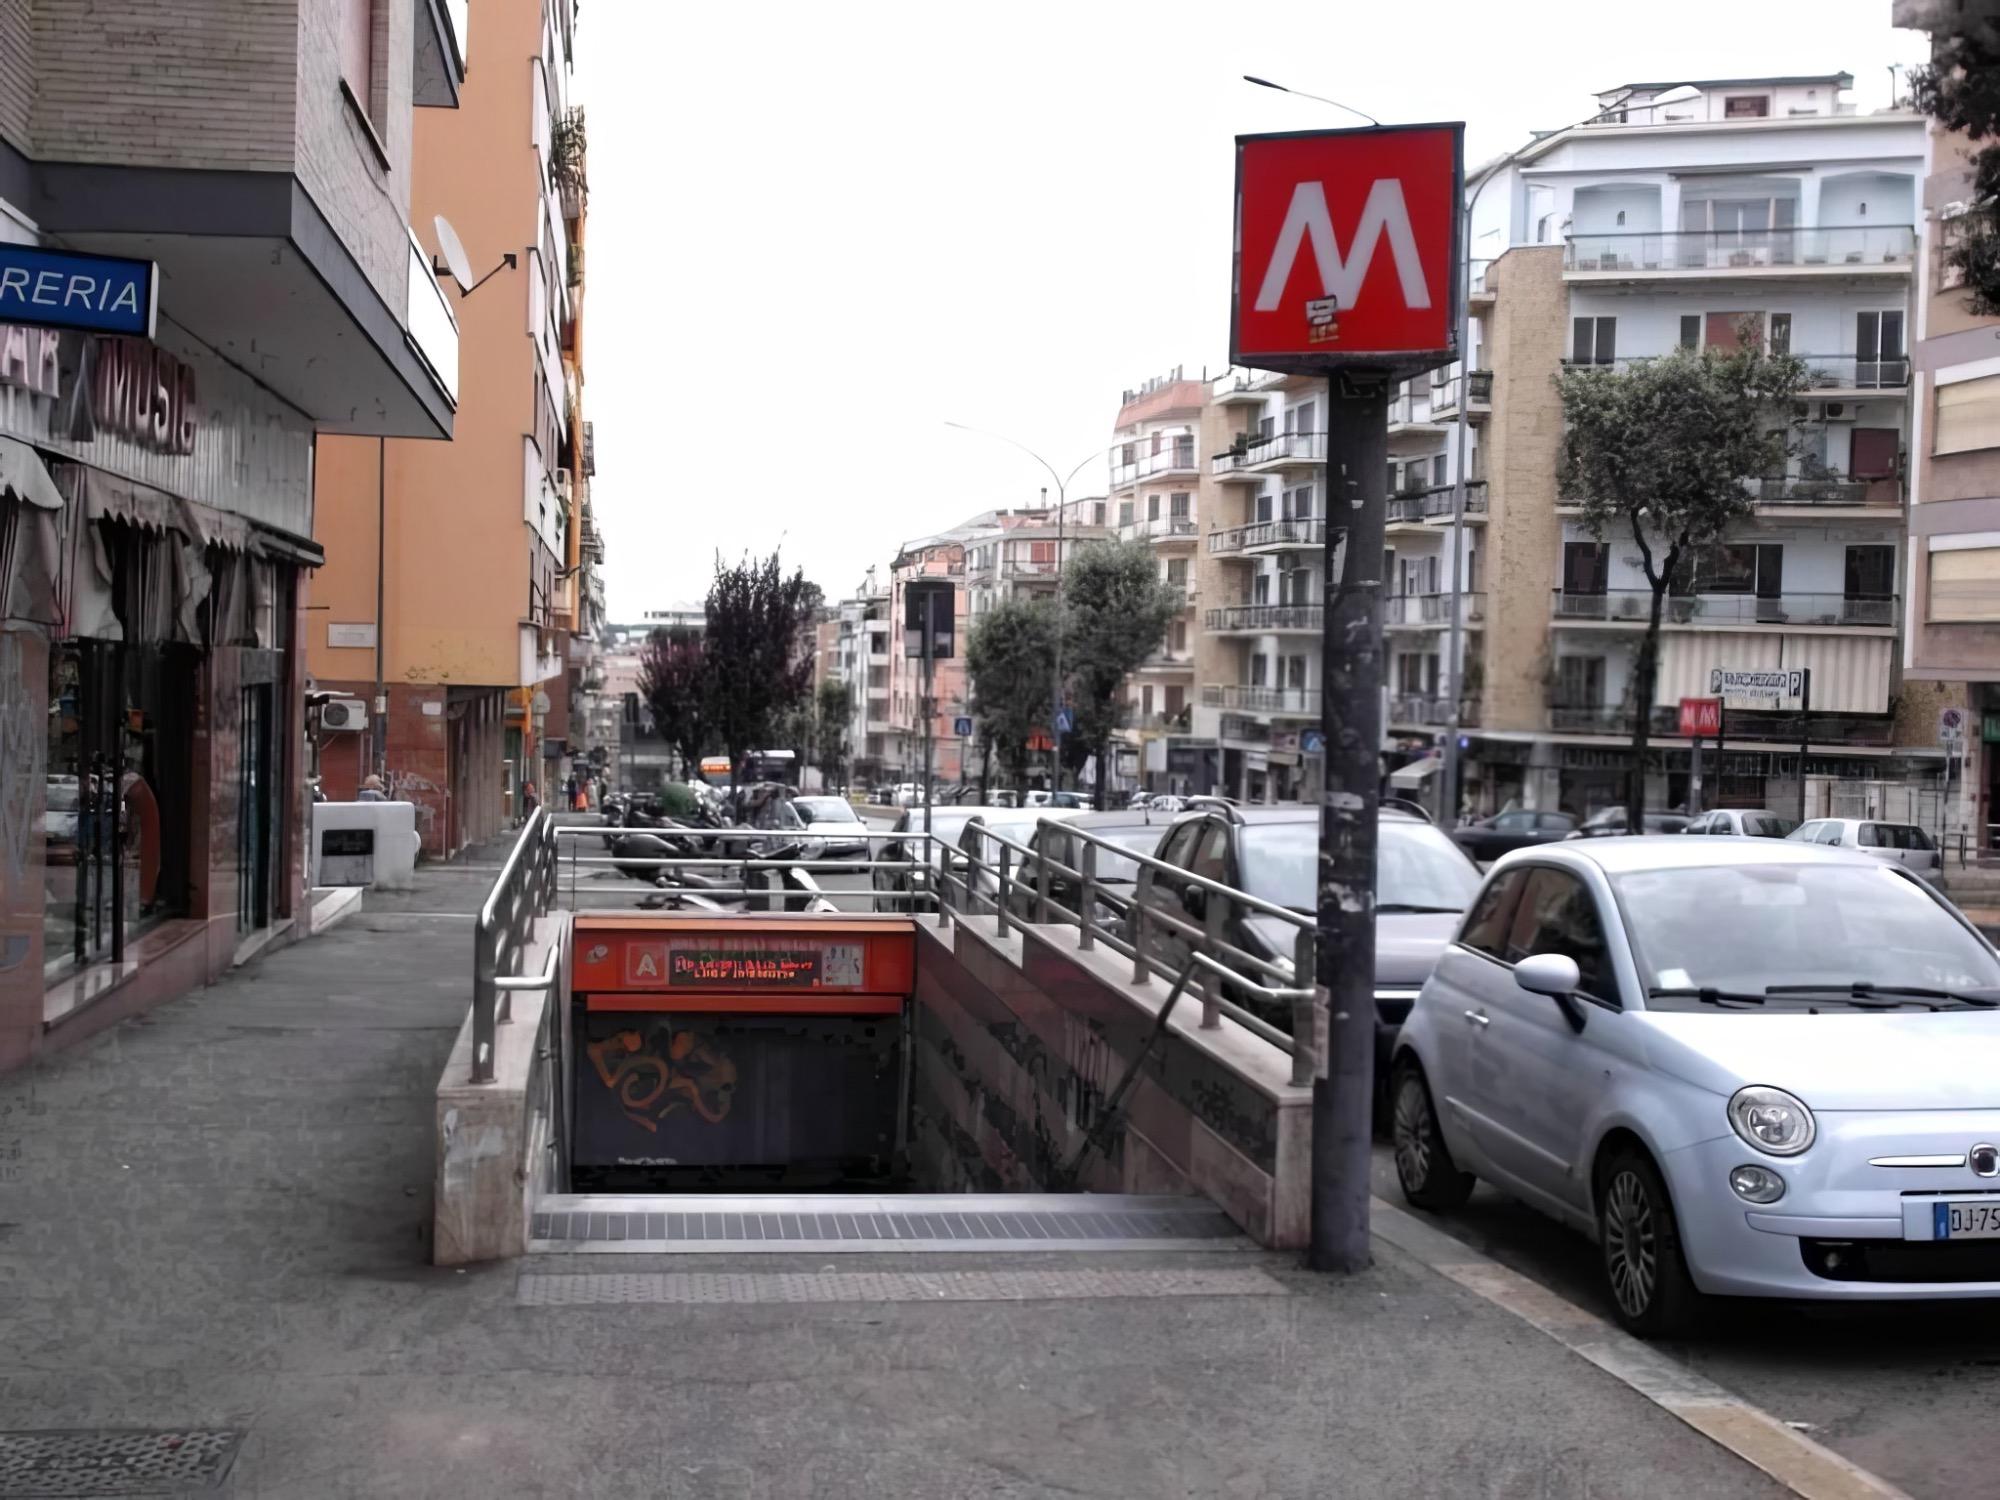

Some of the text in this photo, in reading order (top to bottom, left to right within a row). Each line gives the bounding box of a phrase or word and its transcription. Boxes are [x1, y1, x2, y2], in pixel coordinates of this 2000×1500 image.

[1254, 178, 1432, 312] M
[0, 267, 137, 314] RERIA
[103, 337, 197, 452] MUSIC
[636, 953, 657, 976] A
